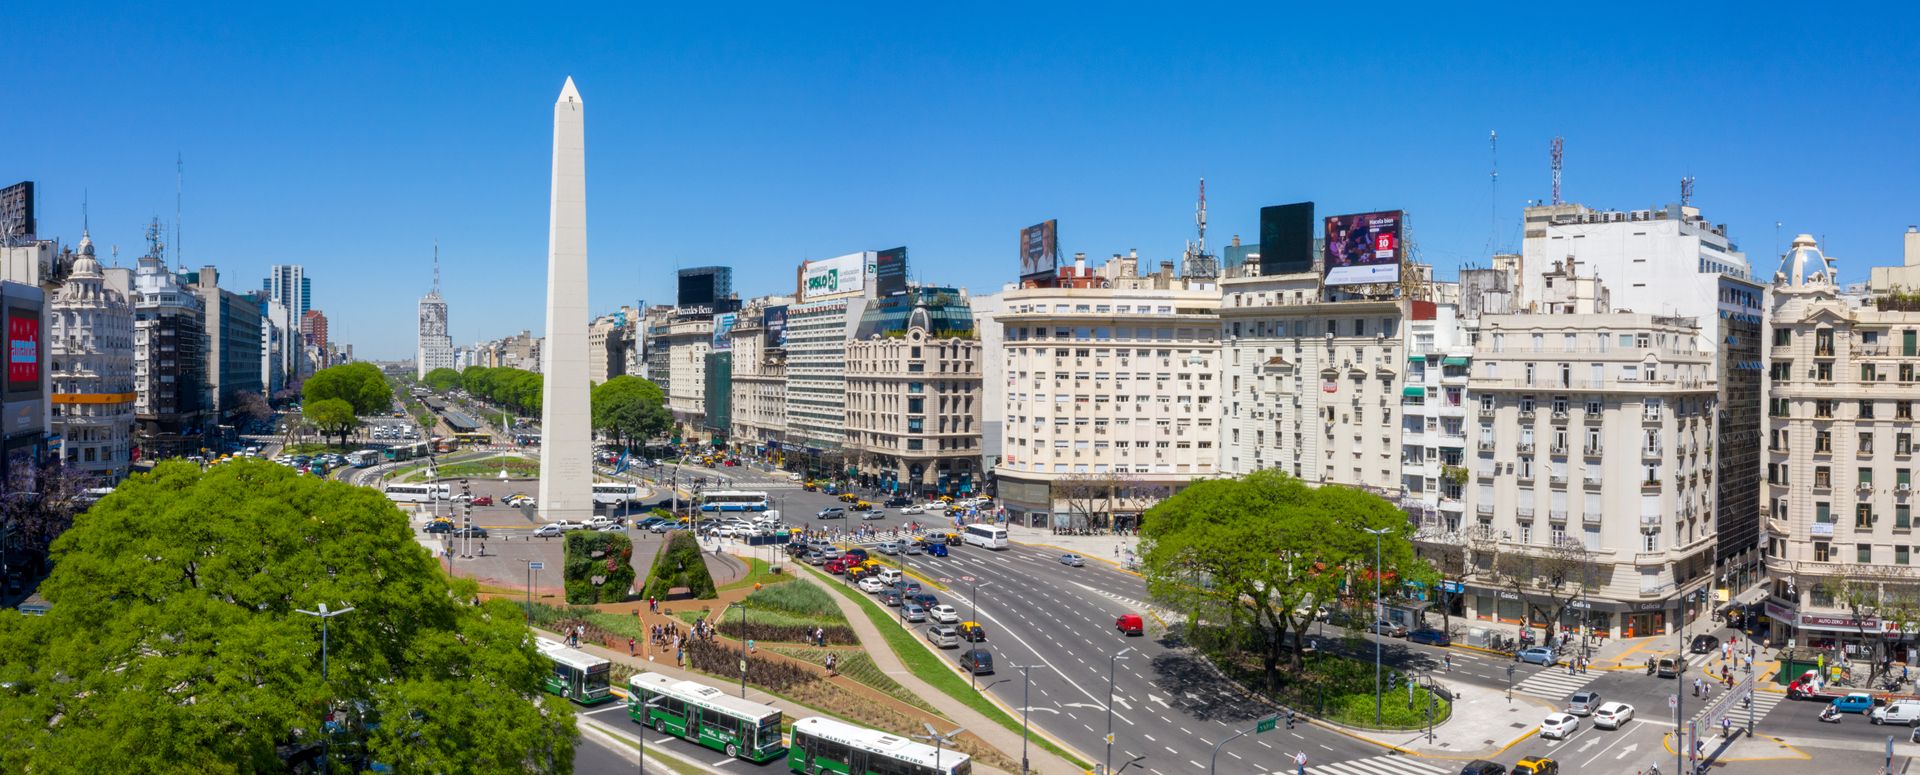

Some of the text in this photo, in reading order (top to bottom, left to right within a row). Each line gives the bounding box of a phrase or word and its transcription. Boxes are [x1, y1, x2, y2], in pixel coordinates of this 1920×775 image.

[1379, 239, 1389, 248] 10
[698, 305, 714, 314] Benz
[1500, 591, 1518, 600] Galicia
[1641, 602, 1660, 610] Galicia
[1845, 644, 1856, 653] FIAT
[894, 753, 924, 764] RETIRO
